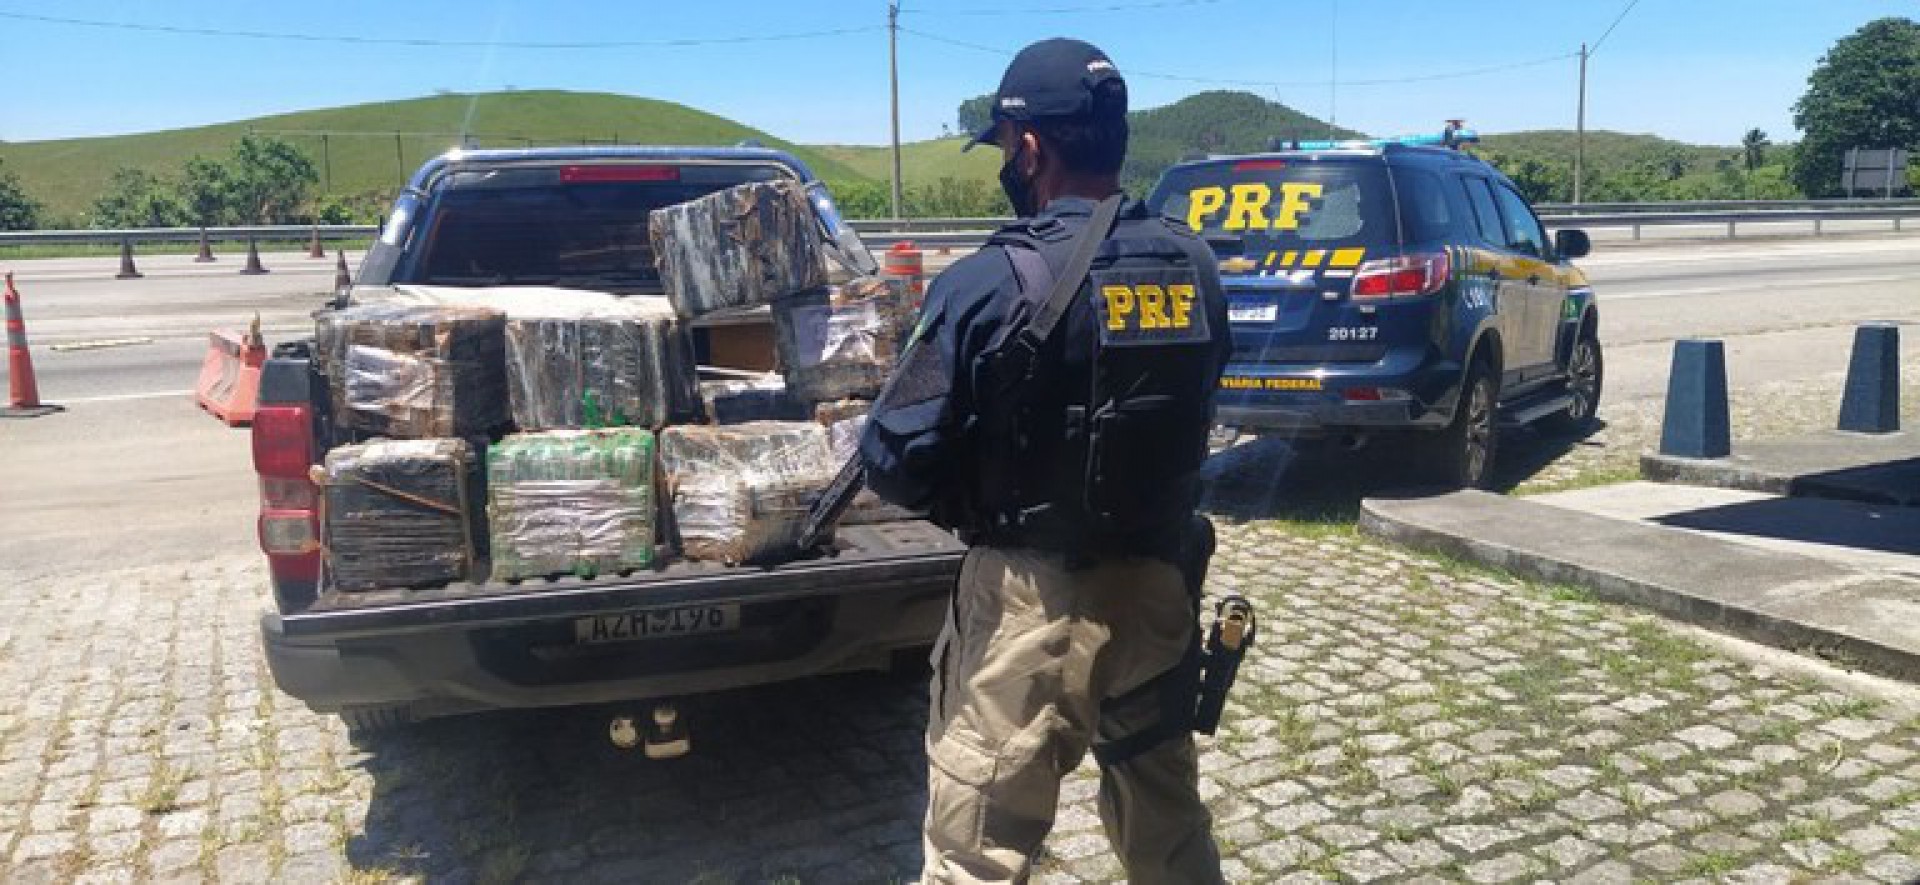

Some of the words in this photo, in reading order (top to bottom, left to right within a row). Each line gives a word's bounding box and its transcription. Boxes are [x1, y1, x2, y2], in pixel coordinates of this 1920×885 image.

[1188, 183, 1323, 231] PRF
[1103, 284, 1195, 330] PRF
[1328, 327, 1379, 341] 20127
[1265, 378, 1323, 391] FEDERAL
